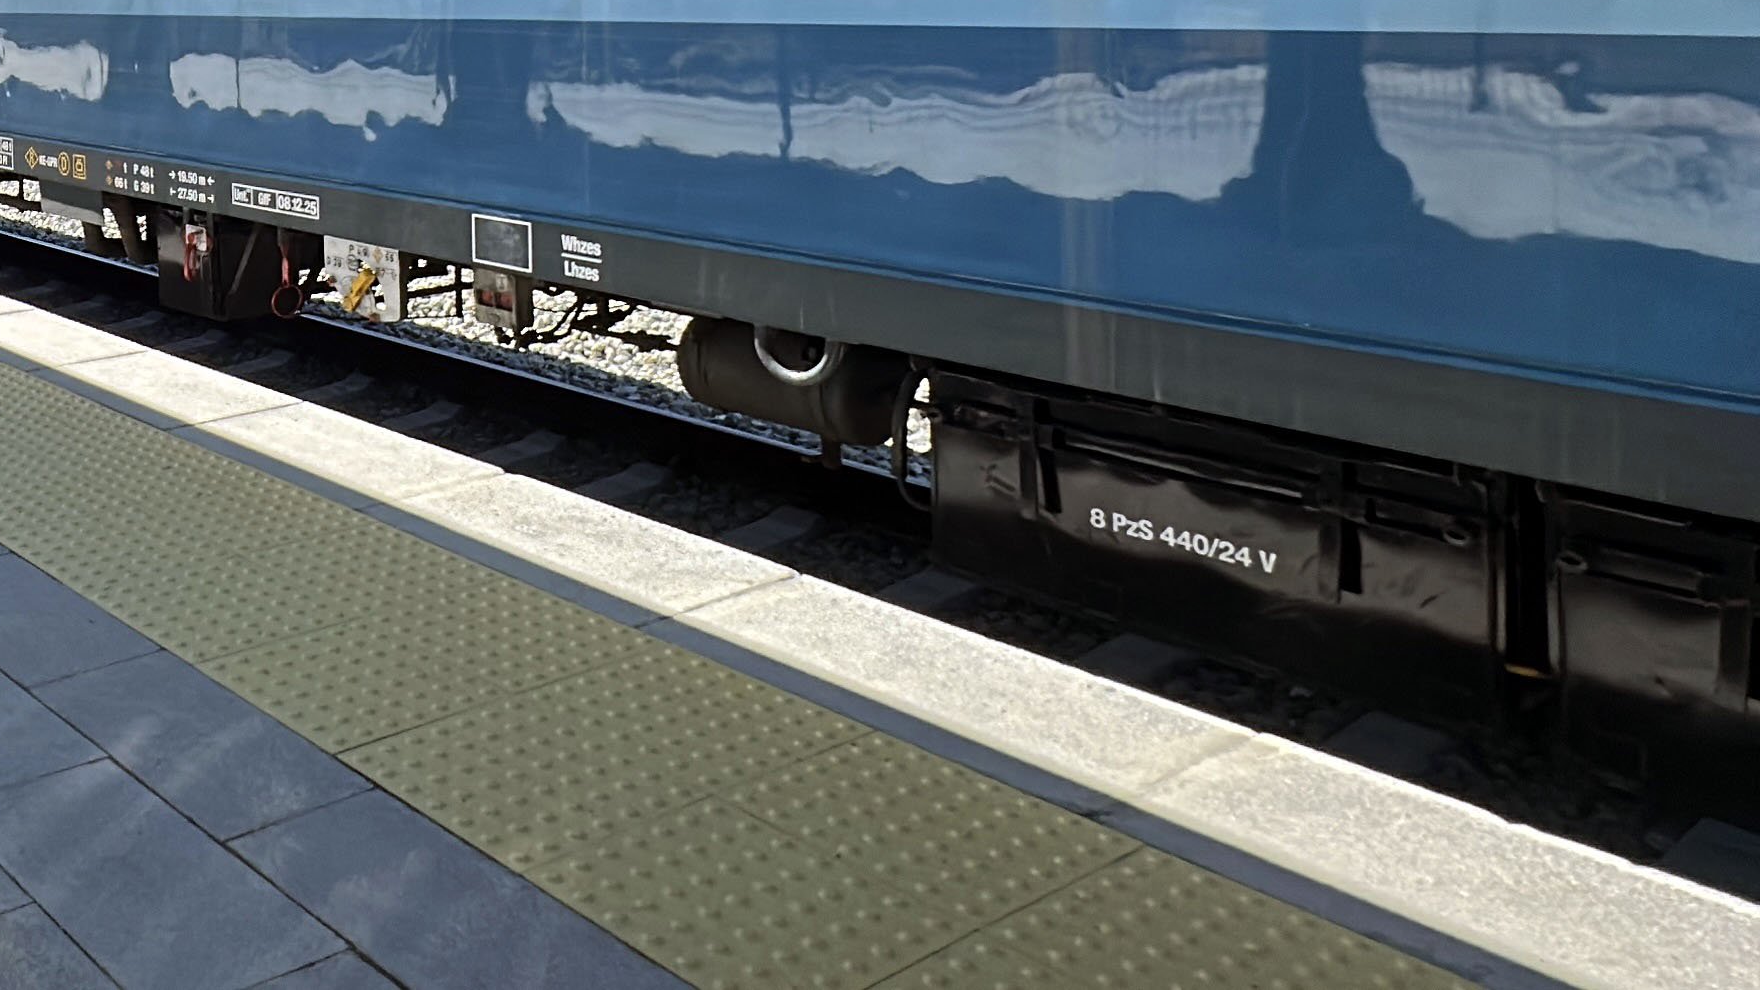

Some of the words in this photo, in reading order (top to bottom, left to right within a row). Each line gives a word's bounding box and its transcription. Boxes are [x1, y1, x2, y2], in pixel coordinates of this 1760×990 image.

[133, 163, 139, 175] P
[177, 170, 198, 185] 19.50
[198, 175, 206, 186] m
[177, 186, 198, 202] 27.50
[198, 192, 206, 203] m
[561, 233, 602, 257] Whzes
[563, 260, 600, 282] Lhzes
[1090, 508, 1106, 529] 8
[1112, 512, 1154, 541] PzS
[1159, 525, 1253, 568] 440/24
[1259, 549, 1277, 574] V
